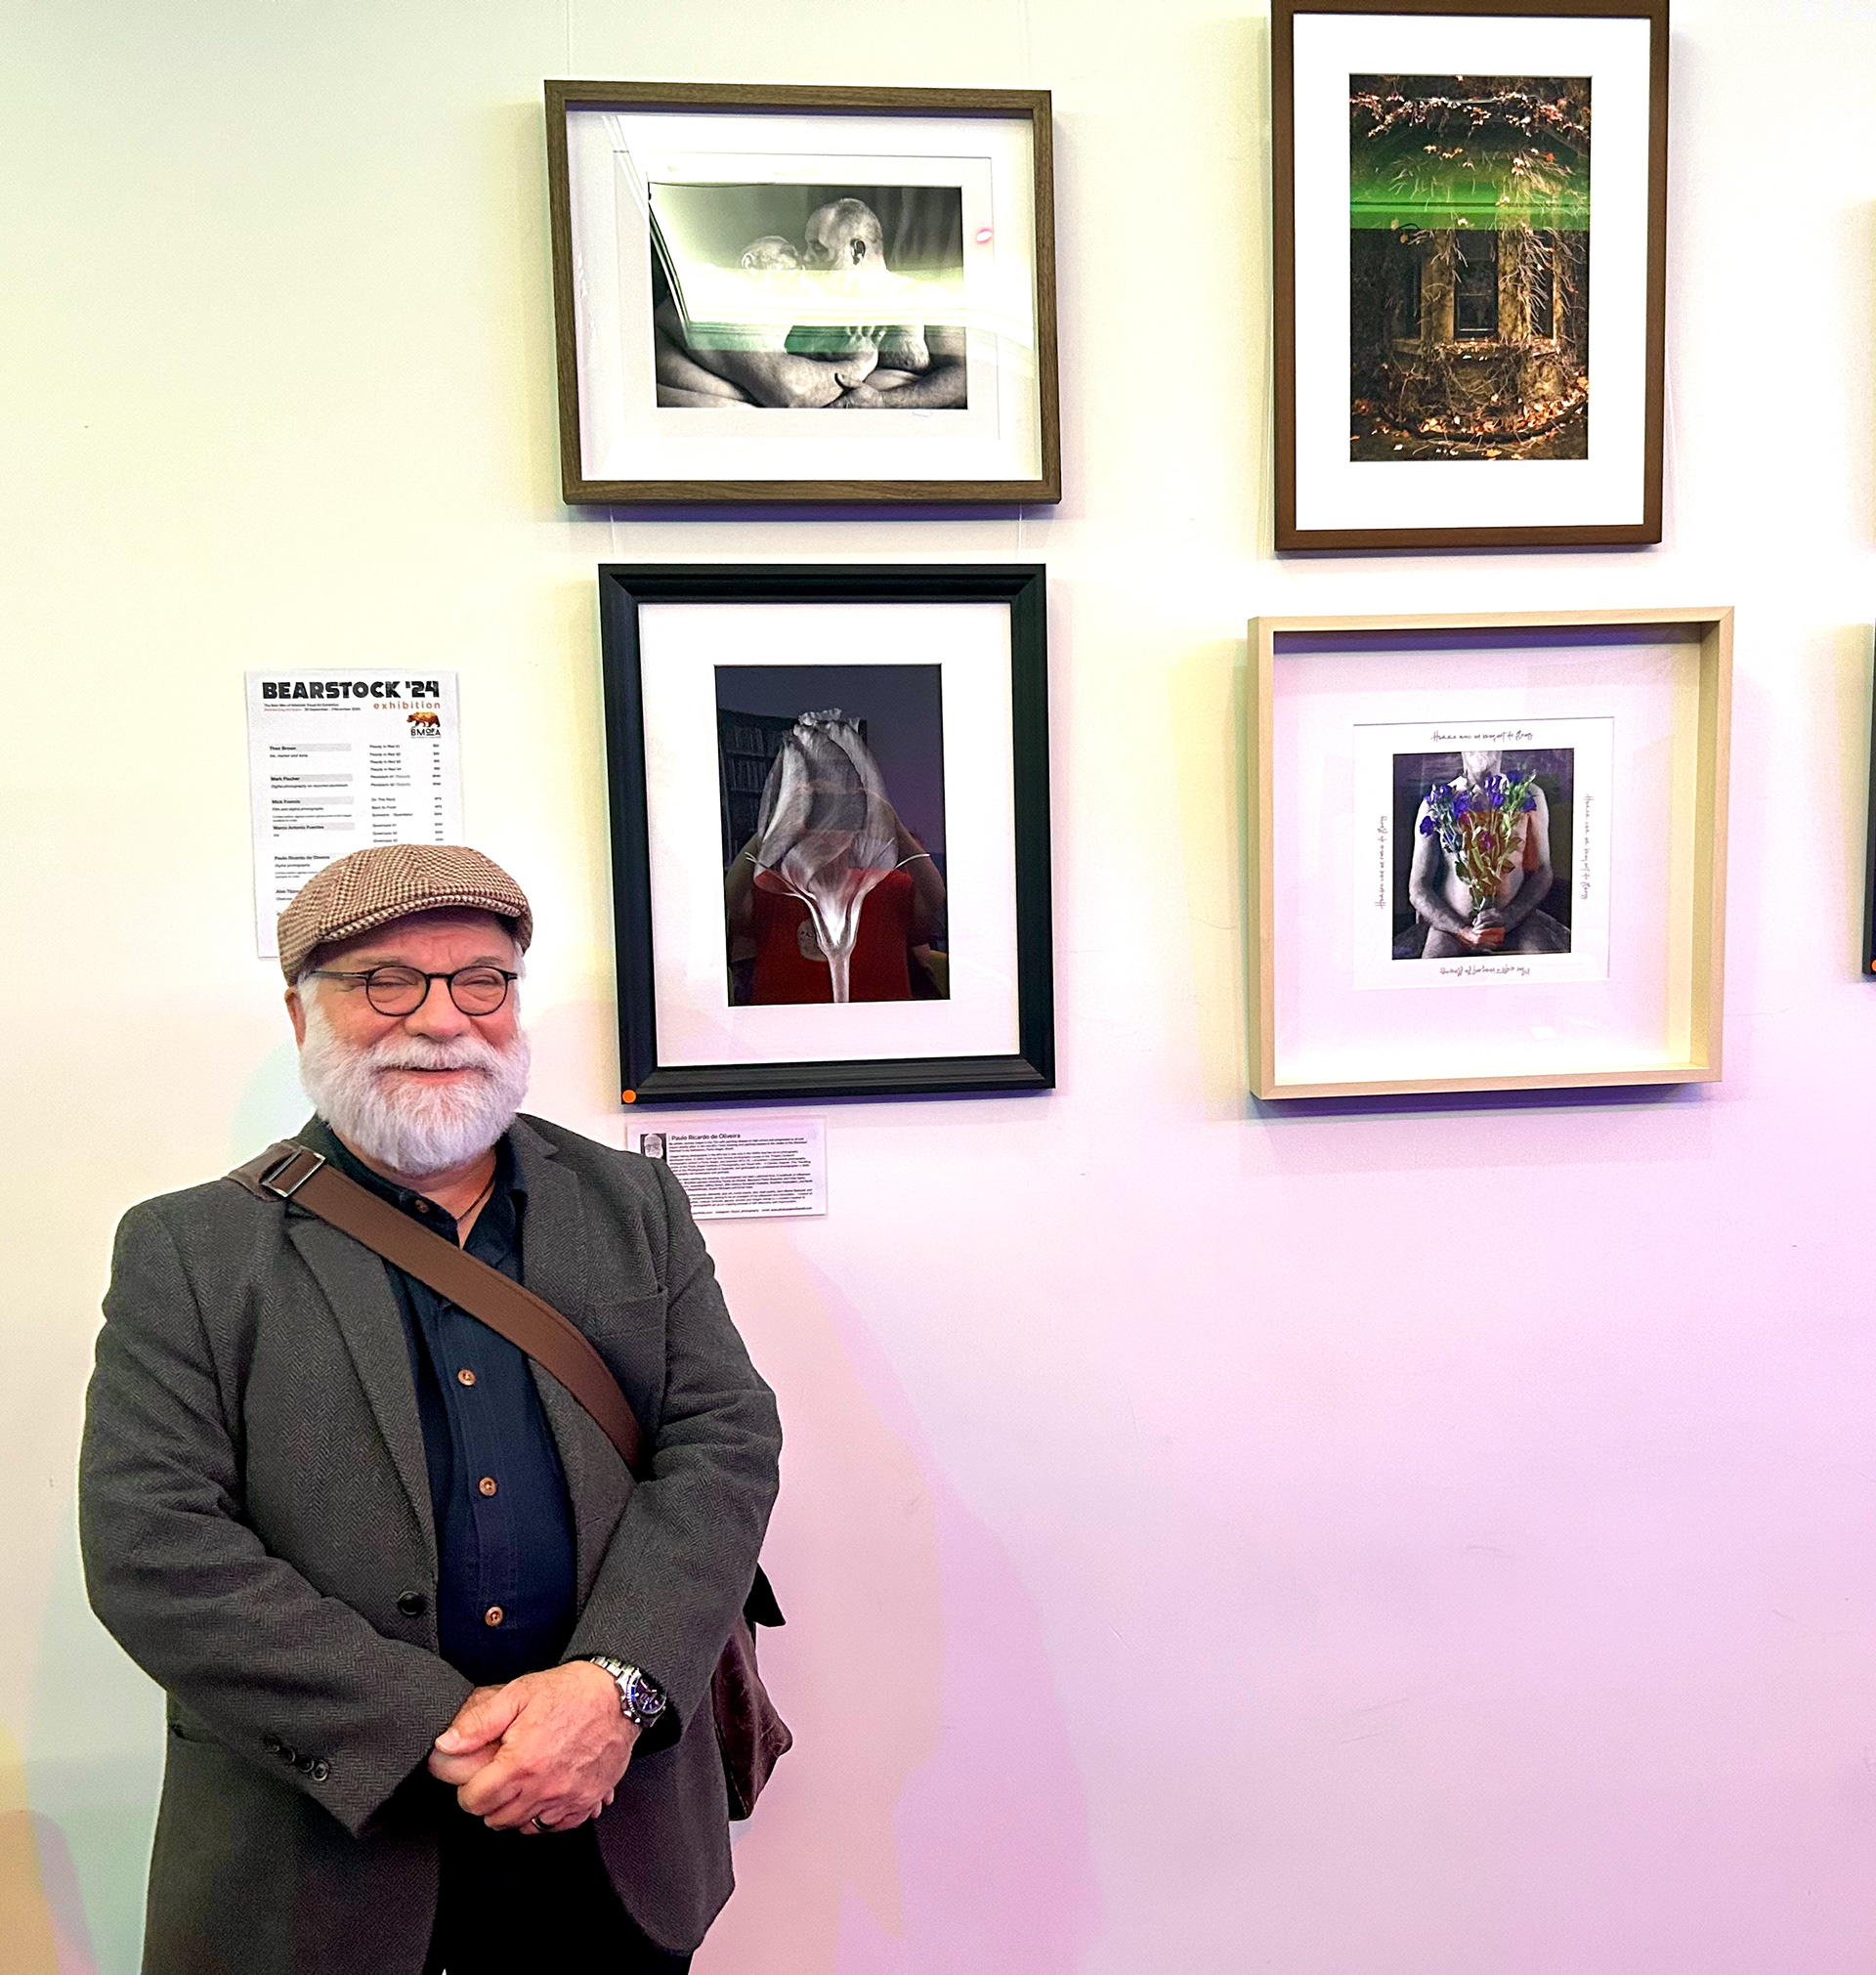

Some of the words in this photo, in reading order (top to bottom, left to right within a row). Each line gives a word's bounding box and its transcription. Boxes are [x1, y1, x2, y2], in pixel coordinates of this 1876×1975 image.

[262, 681, 402, 700] BEARSTOCK
[405, 680, 440, 699] '24
[373, 701, 441, 709] exhibition
